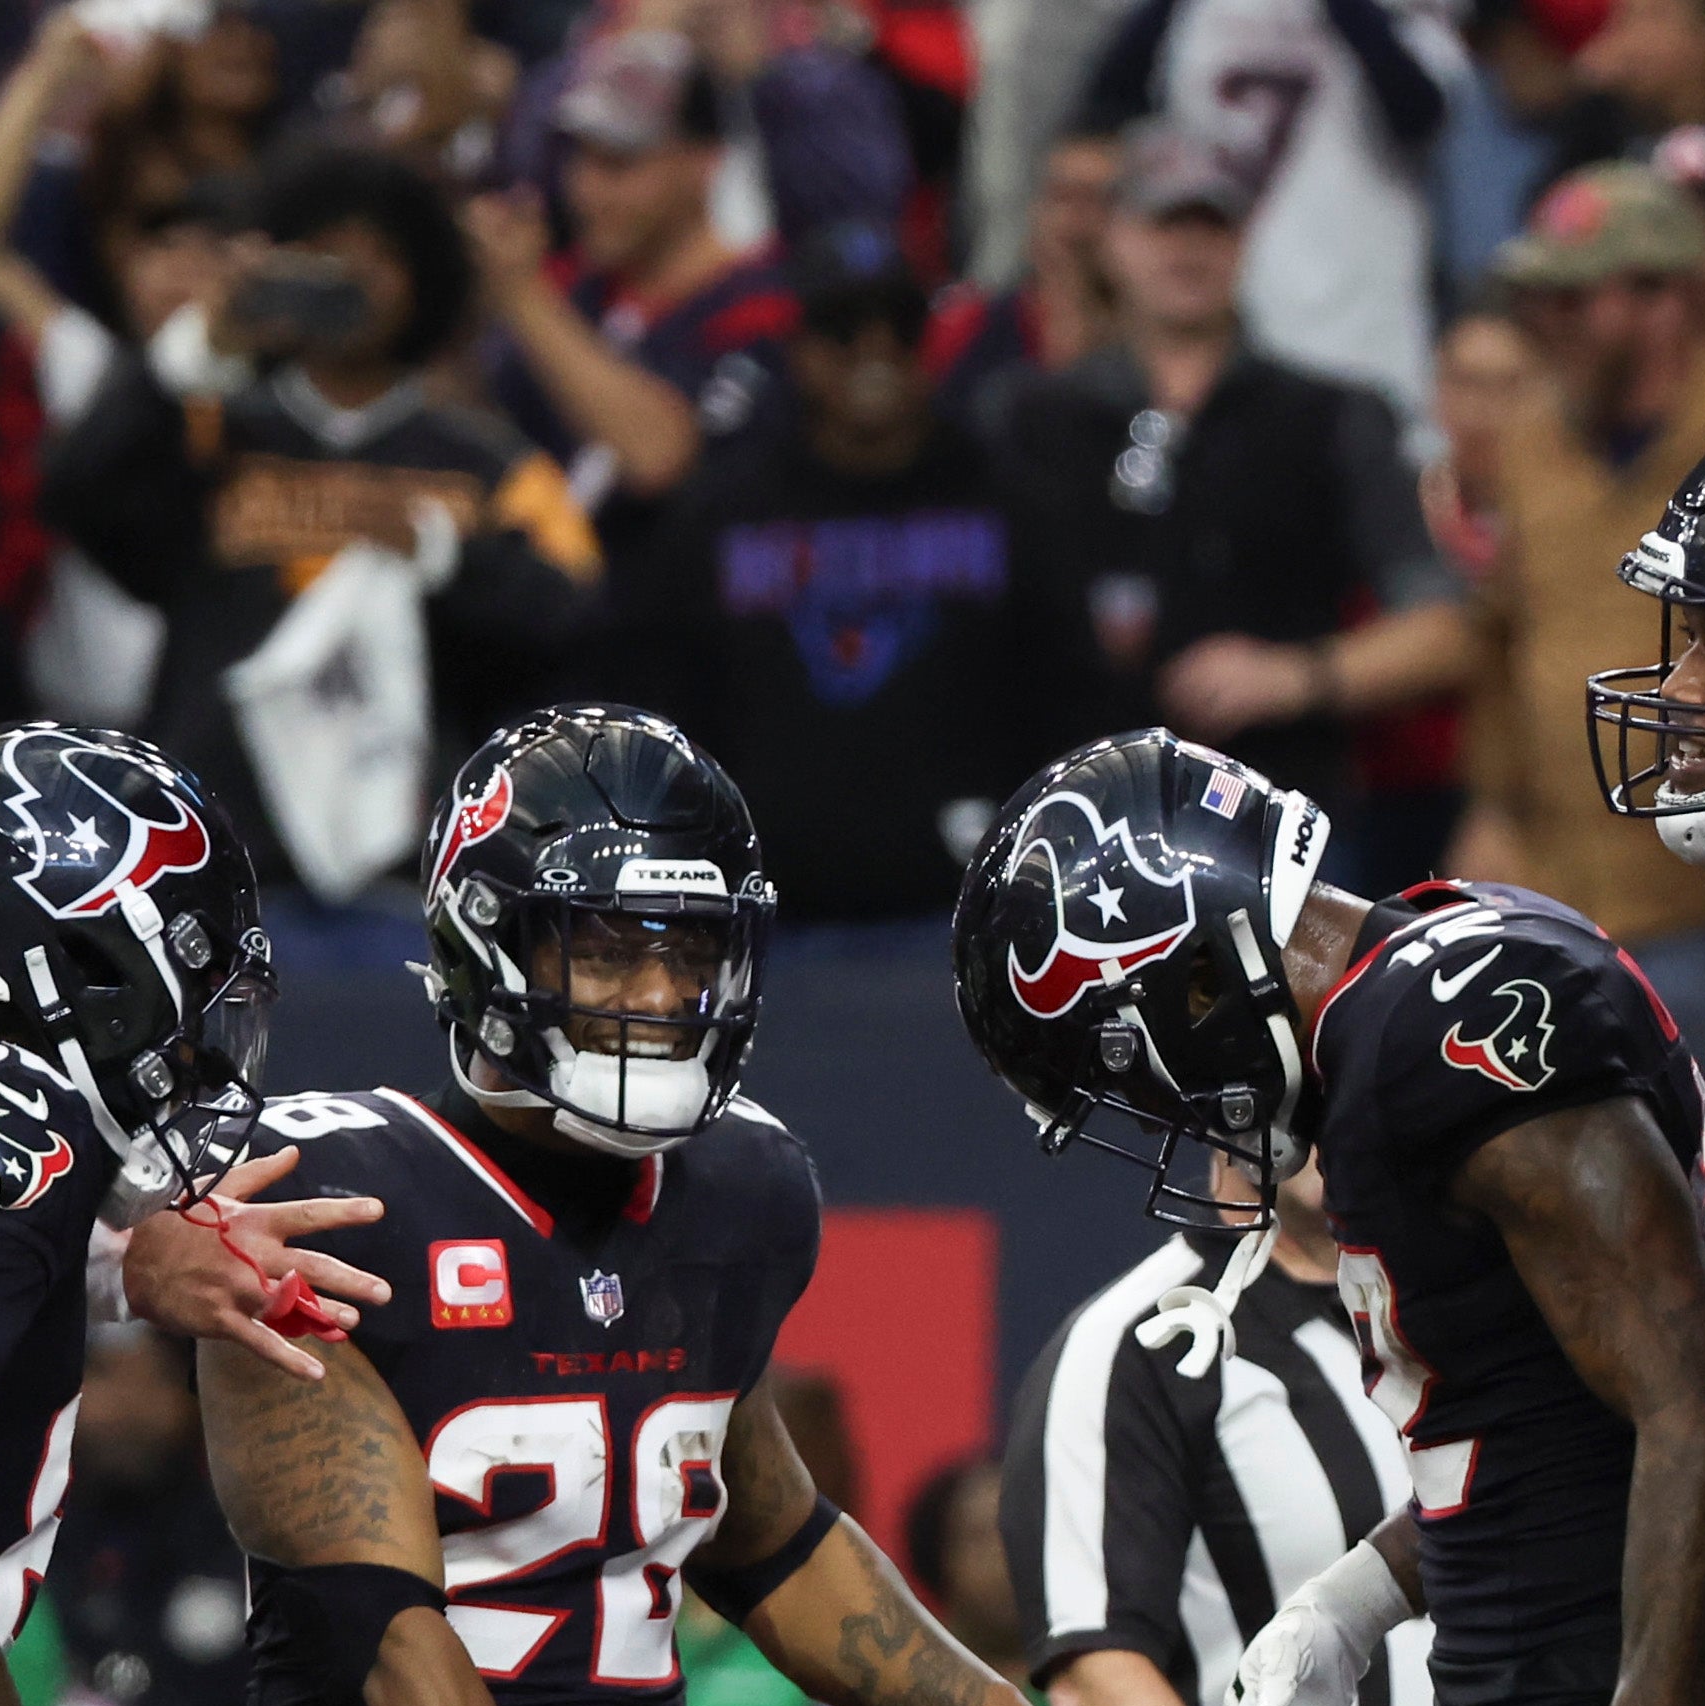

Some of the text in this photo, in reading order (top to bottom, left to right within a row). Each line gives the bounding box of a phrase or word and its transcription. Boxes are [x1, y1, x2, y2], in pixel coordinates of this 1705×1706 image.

[1290, 797, 1321, 867] HOU
[634, 869, 718, 881] TEXANS
[435, 1245, 506, 1306] C
[529, 1347, 688, 1377] TEXANS
[422, 1390, 739, 1688] 28
